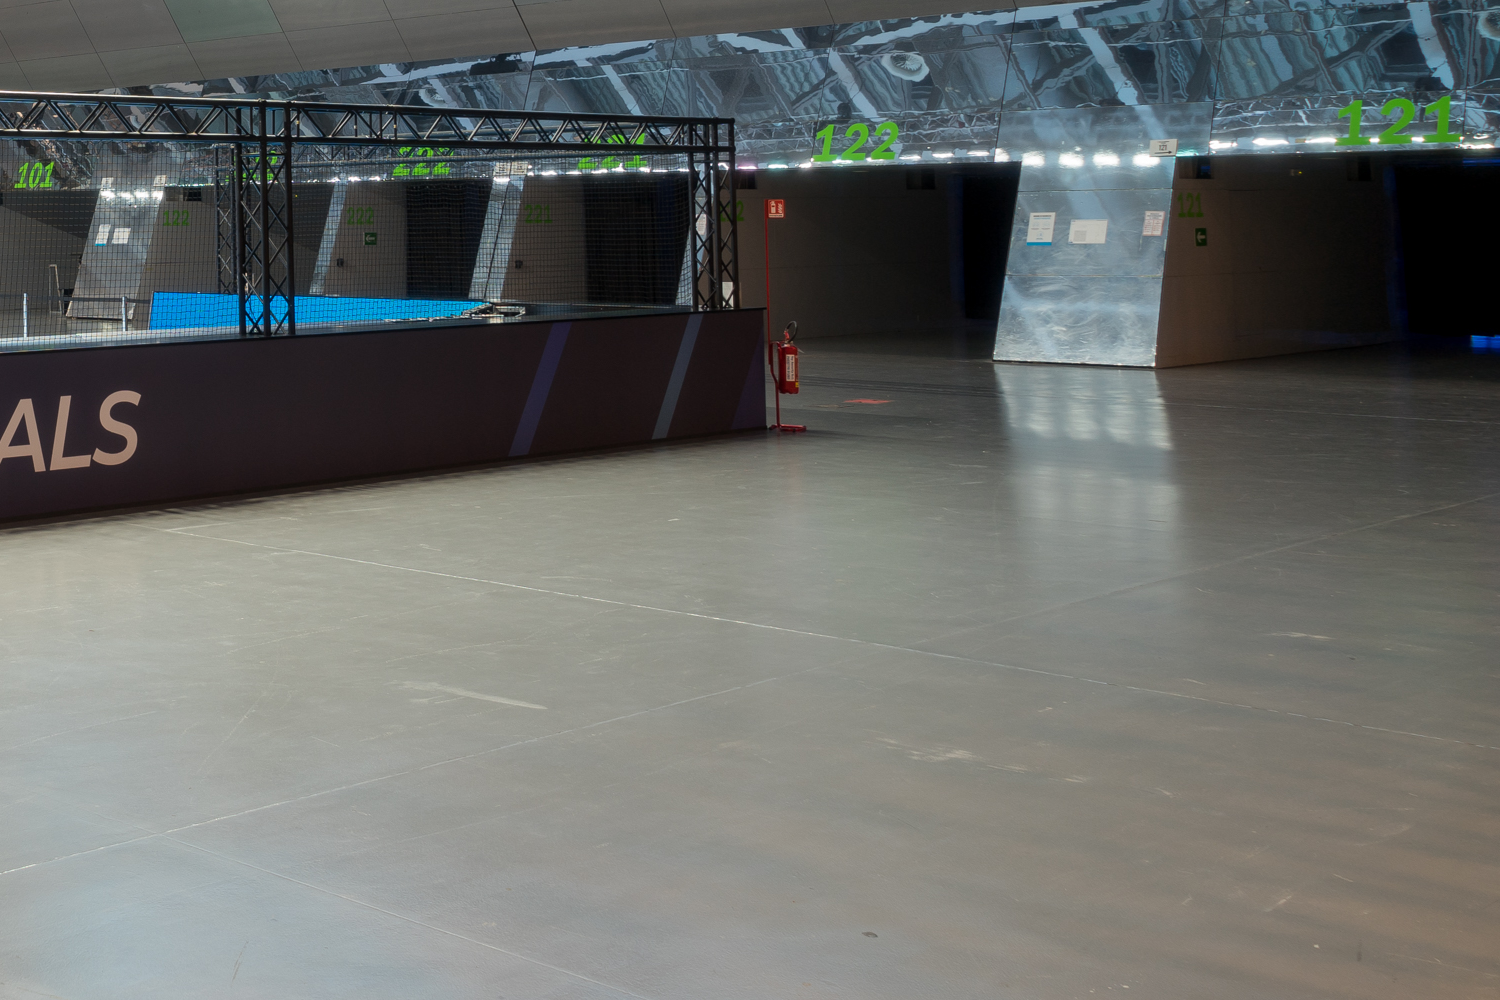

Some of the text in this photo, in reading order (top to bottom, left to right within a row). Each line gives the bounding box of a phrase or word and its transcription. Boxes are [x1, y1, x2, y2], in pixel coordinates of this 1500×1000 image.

[1335, 96, 1462, 146] 121
[813, 121, 899, 162] 122
[14, 161, 55, 189] 101
[346, 206, 374, 225] 222
[524, 204, 553, 224] 221
[1177, 192, 1204, 218] 121
[163, 210, 190, 227] 122
